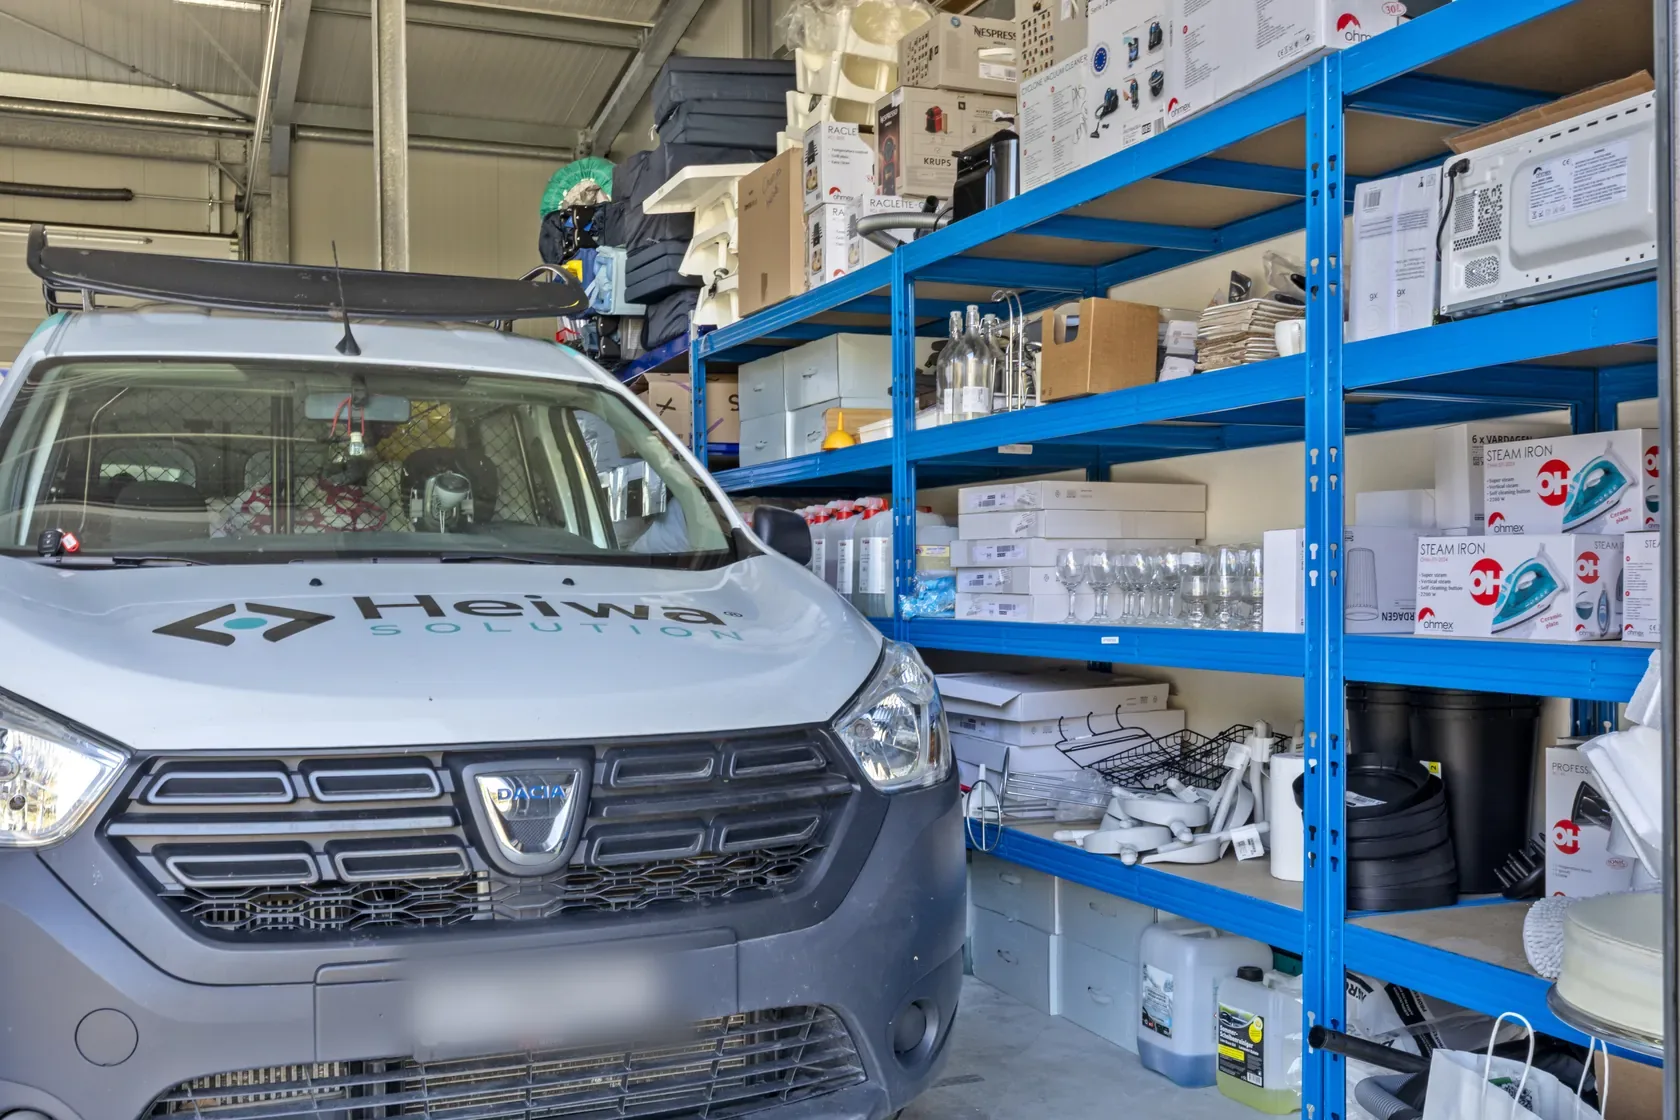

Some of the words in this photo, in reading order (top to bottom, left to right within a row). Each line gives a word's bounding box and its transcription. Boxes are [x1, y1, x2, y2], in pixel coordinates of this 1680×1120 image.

[1065, 54, 1088, 72] CLEANER
[1171, 102, 1191, 117] ohmex
[923, 157, 952, 167] KRUPS
[1486, 448, 1522, 461] STEAM
[1524, 444, 1553, 458] IRON
[1494, 524, 1524, 533] ohmex
[1420, 543, 1455, 556] STEAM
[1457, 542, 1486, 555] IRON
[1594, 541, 1619, 550] STEAM
[1576, 559, 1600, 577] OH
[369, 621, 745, 642] SOLUTION
[1424, 620, 1453, 629] ohmex
[497, 785, 566, 800] DACIA
